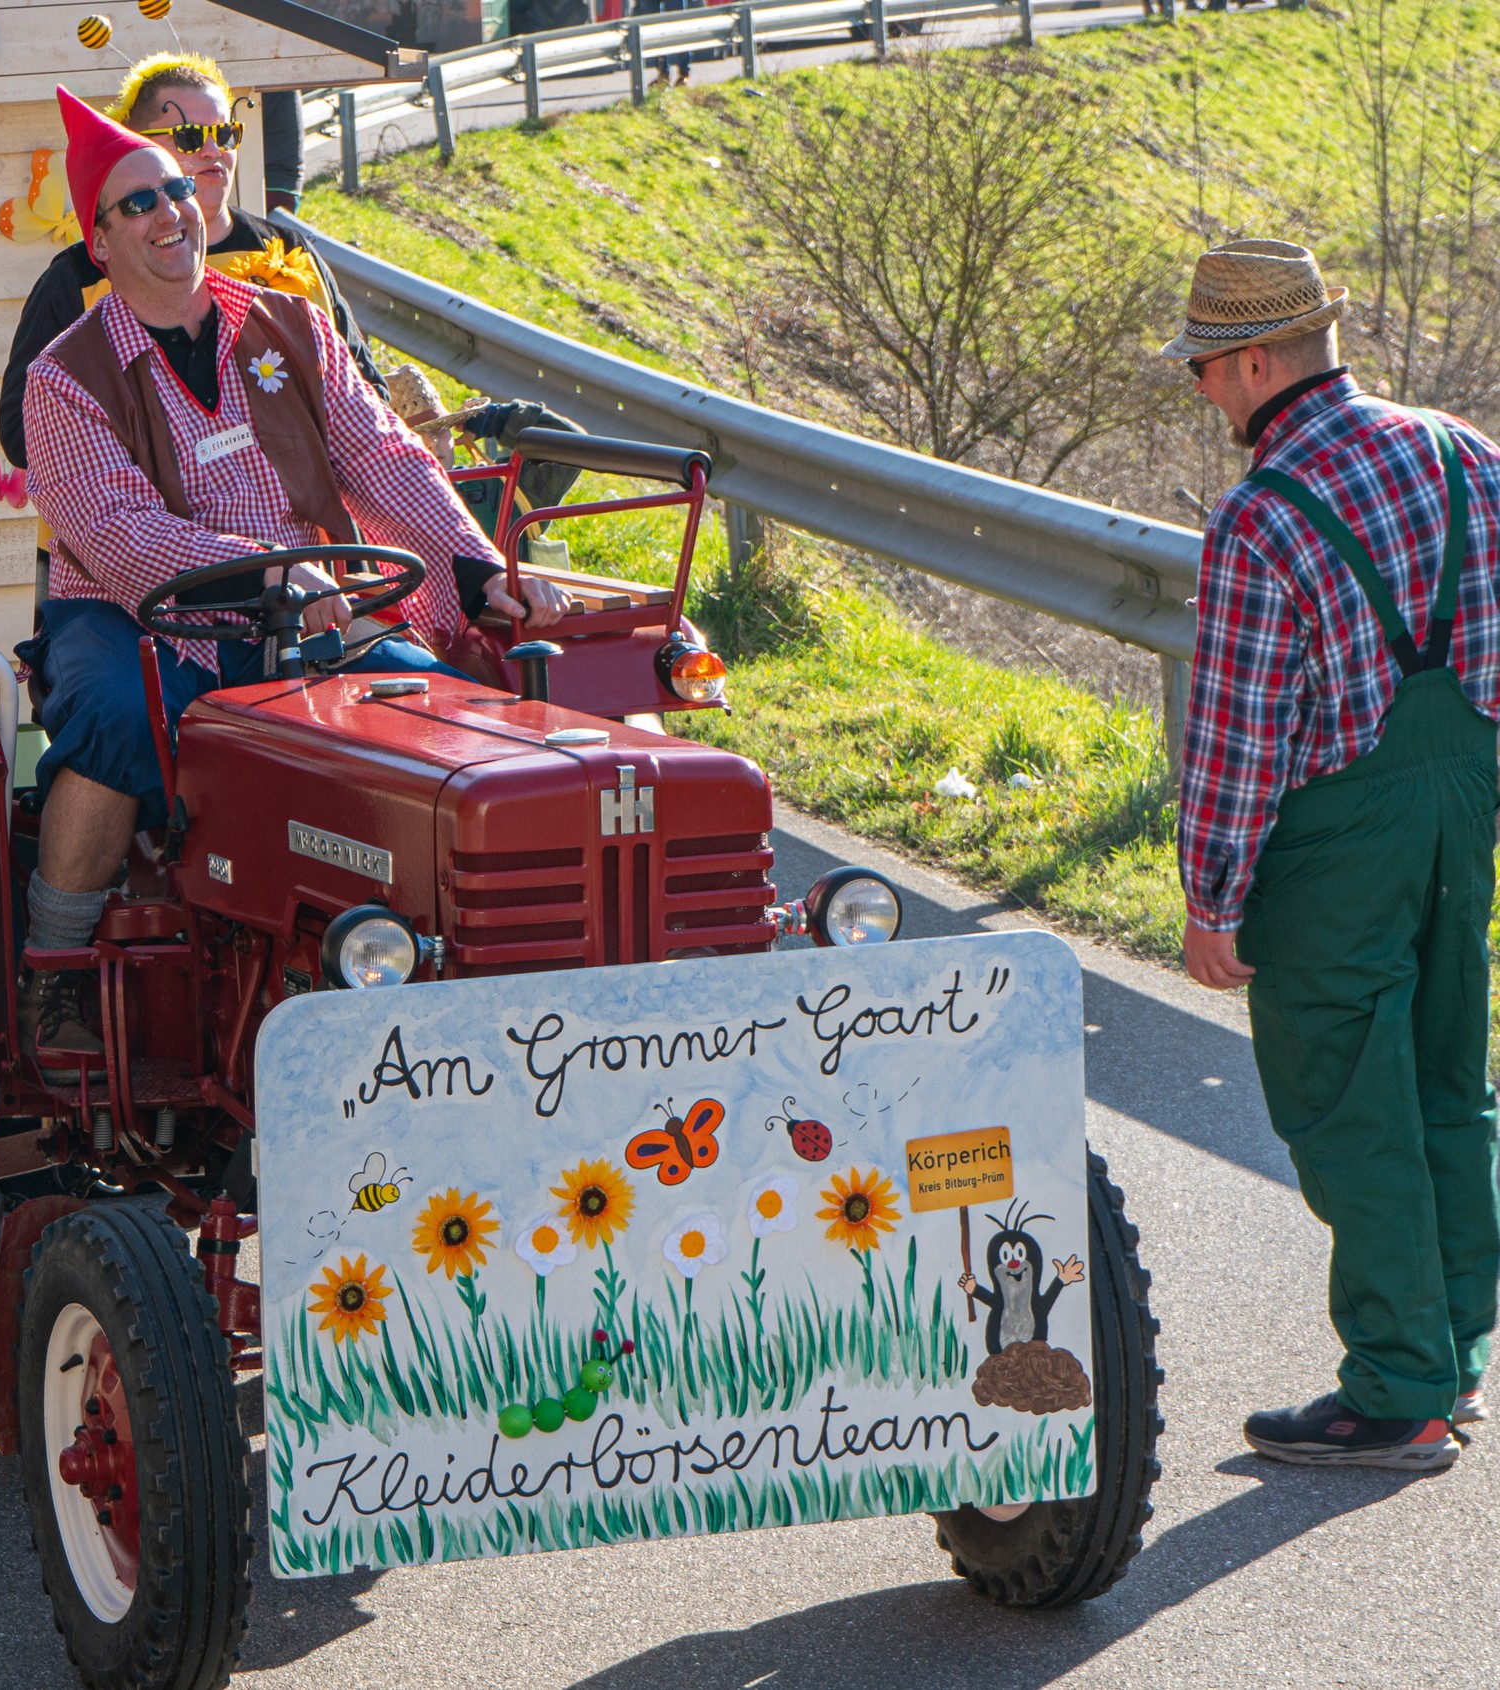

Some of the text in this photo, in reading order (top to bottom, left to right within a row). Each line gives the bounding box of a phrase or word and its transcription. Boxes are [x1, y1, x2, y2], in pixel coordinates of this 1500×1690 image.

[506, 1013, 787, 1117] Gronner
[908, 1139, 1011, 1172] Körperich
[918, 1172, 1005, 1194] Kreis Bitburg-Prüm
[302, 1386, 1000, 1527] Kleiderbörsenteam
